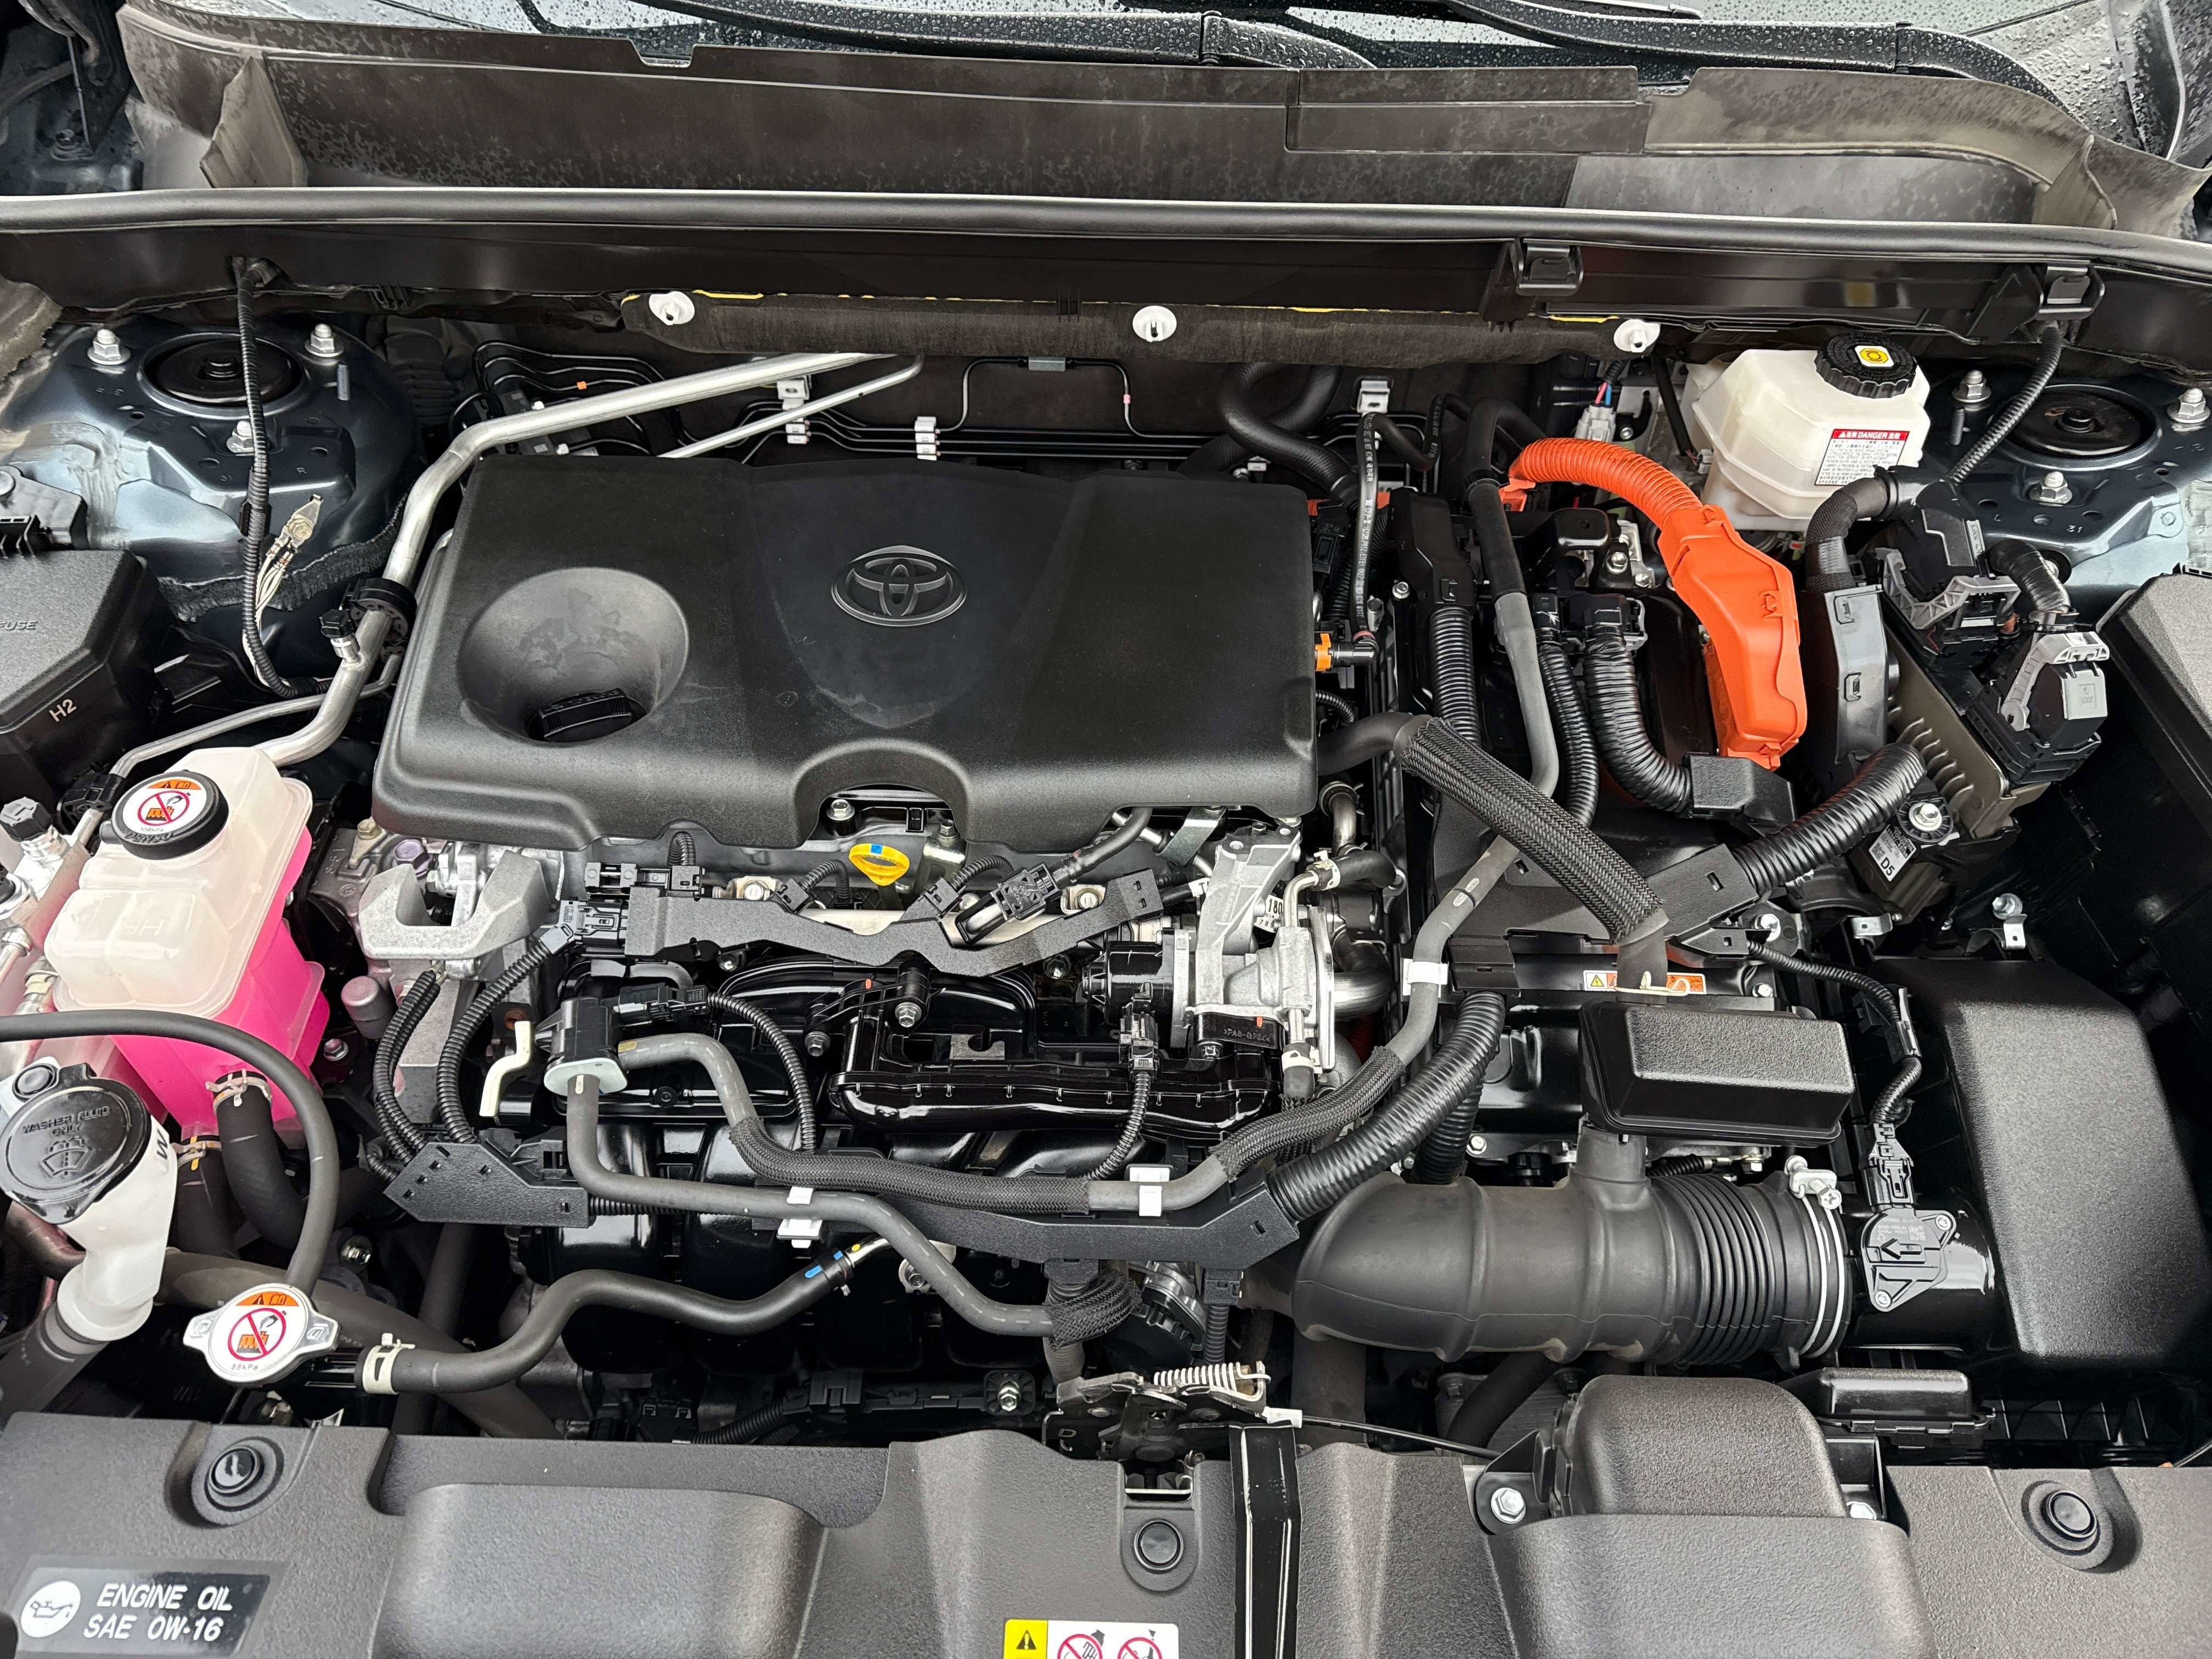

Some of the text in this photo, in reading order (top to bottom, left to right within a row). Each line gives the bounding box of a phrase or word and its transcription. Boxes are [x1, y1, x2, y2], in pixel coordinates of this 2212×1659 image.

[48, 699, 77, 722] H2
[1880, 857, 1895, 876] D5
[21, 1105, 110, 1134] WASHER FLUID
[52, 1124, 82, 1136] ONLY
[97, 1583, 233, 1611] ENGINE OIL
[83, 1614, 137, 1638] SAE
